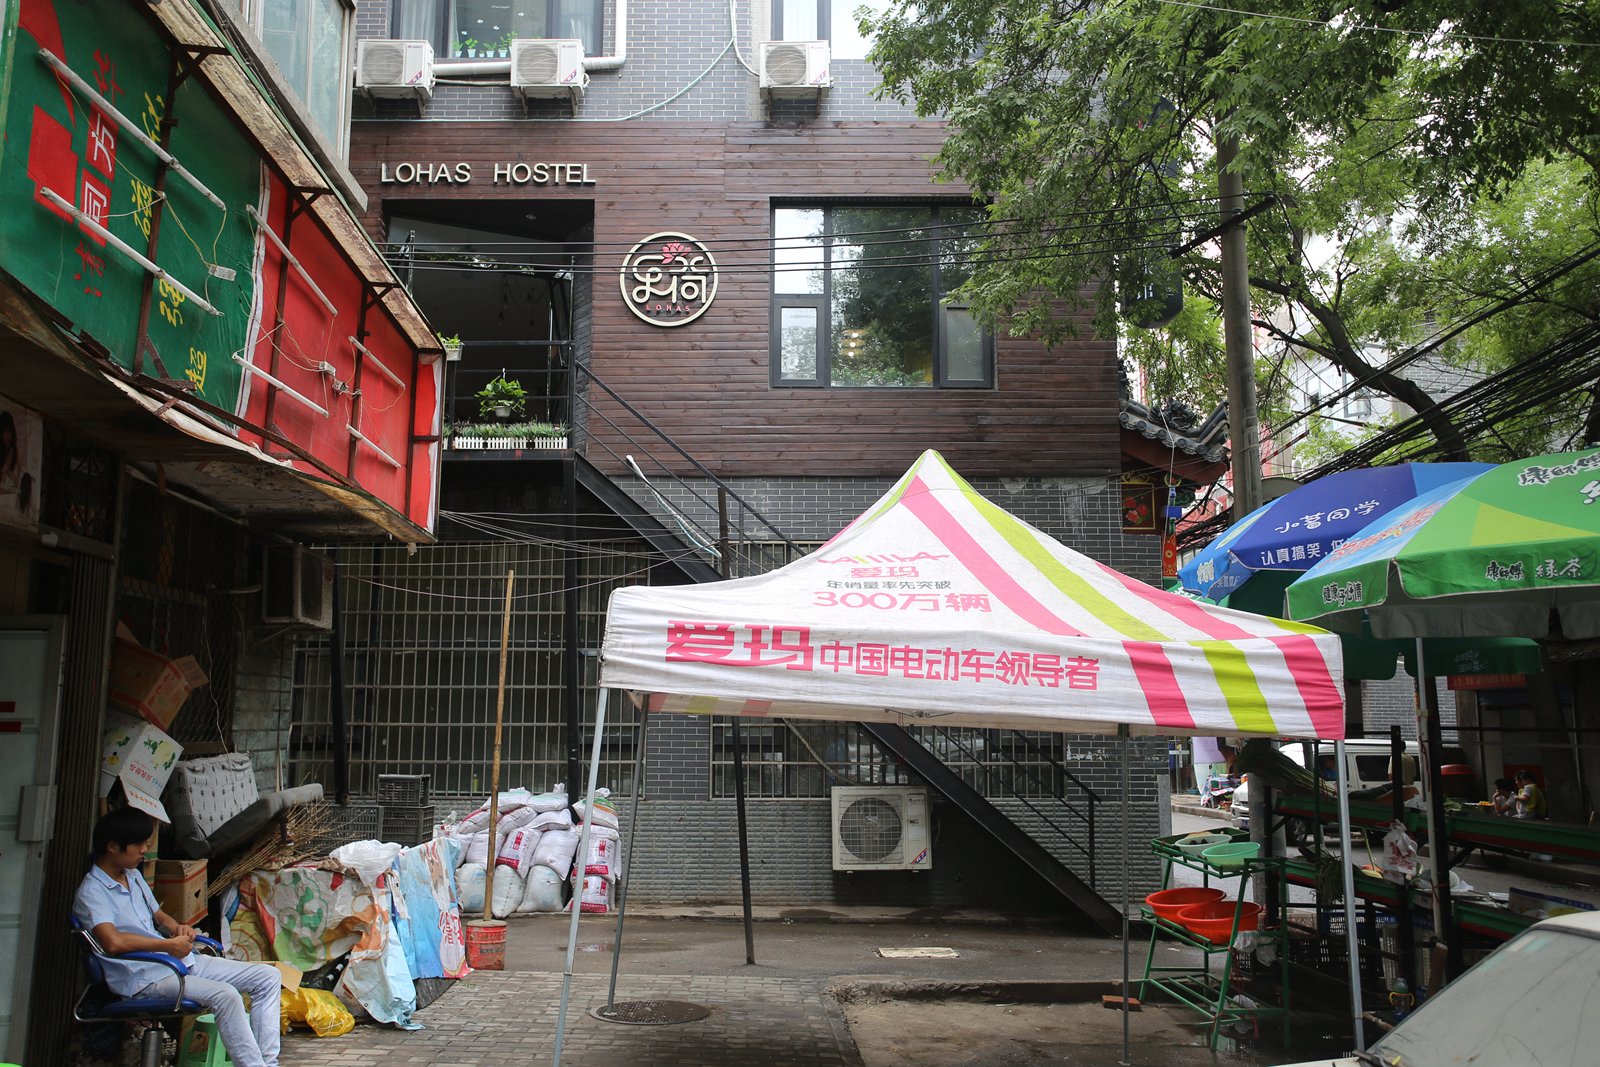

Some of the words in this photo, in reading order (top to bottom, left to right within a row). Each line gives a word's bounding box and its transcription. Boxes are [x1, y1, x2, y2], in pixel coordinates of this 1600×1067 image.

[380, 162, 472, 184] LOHAS
[493, 162, 597, 185] HOSTEL
[645, 304, 691, 312] LOHAS
[1274, 500, 1380, 534] 小茗同学
[850, 566, 920, 579] 爱玛
[826, 580, 952, 590] 年销量率先突破
[812, 591, 993, 613] 300万辆
[665, 620, 814, 672] 爱玛
[819, 640, 1100, 691] 中国电动车领导者
